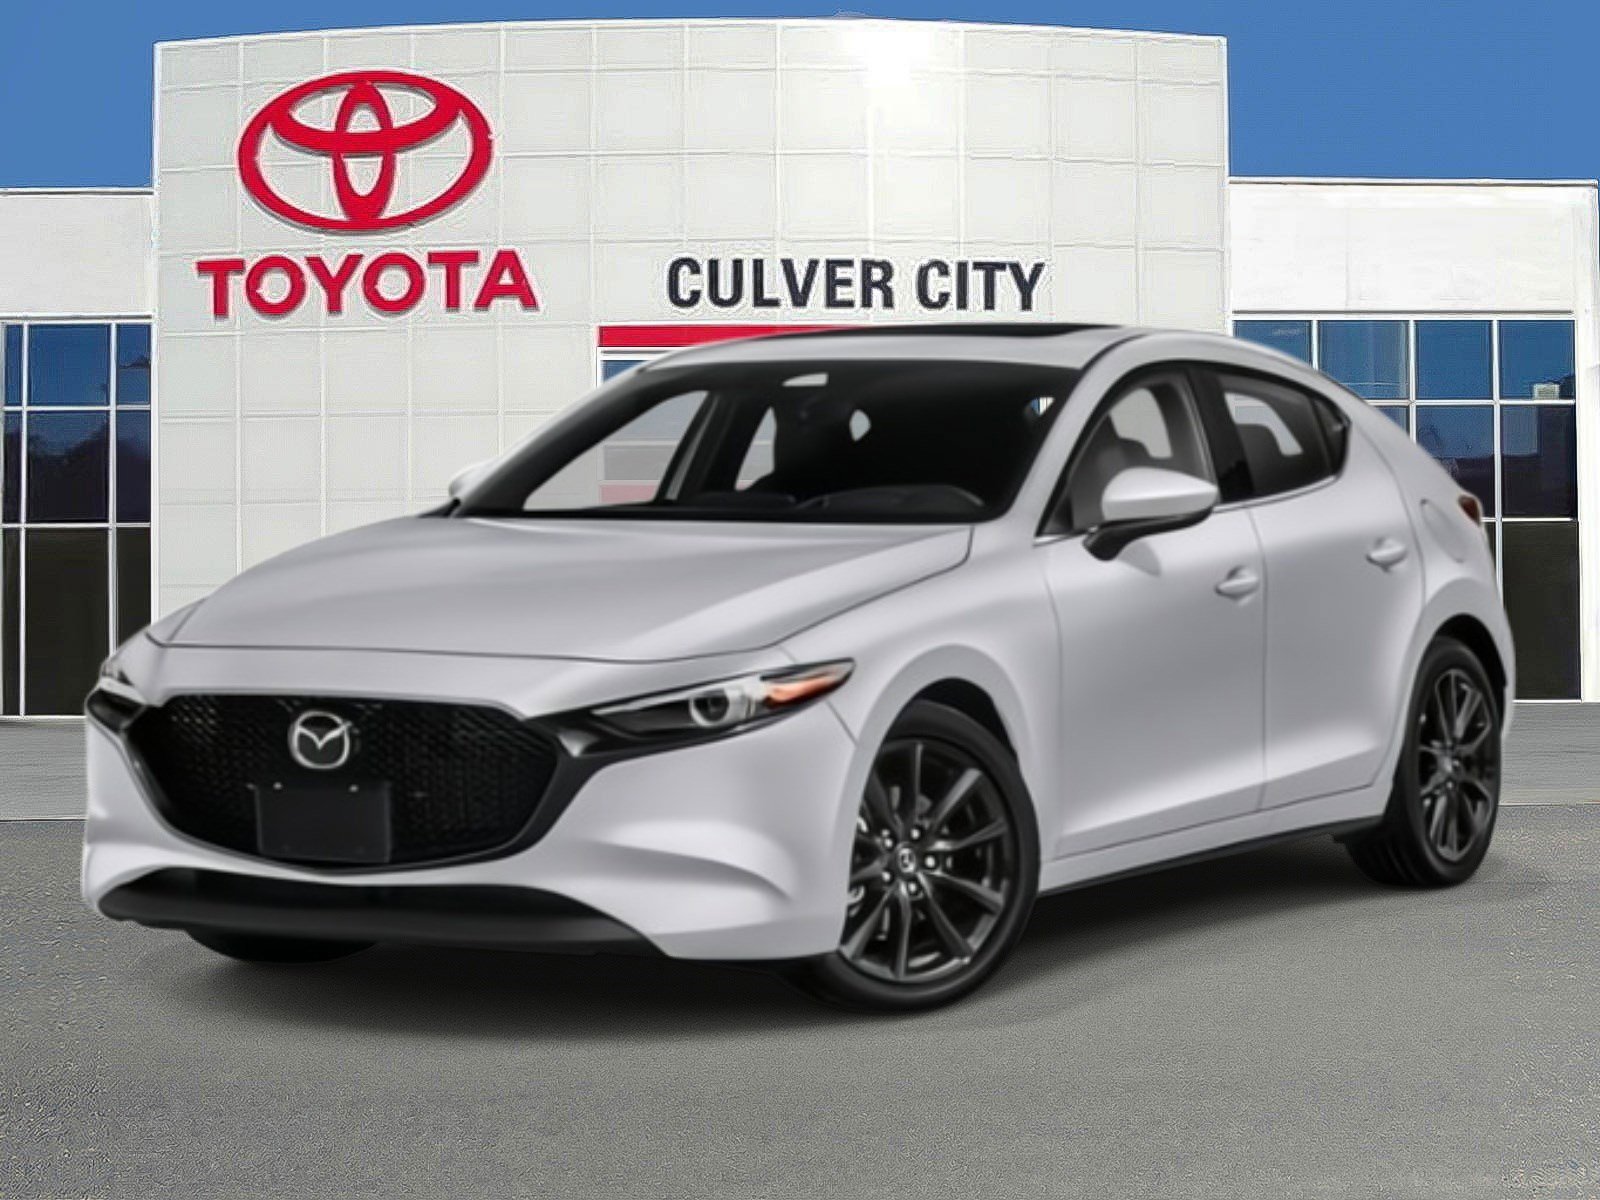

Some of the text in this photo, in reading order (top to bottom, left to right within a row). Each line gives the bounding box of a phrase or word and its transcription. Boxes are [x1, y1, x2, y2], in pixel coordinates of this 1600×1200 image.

[196, 249, 538, 318] TOYOTA
[667, 257, 1046, 312] CULVER CITY
